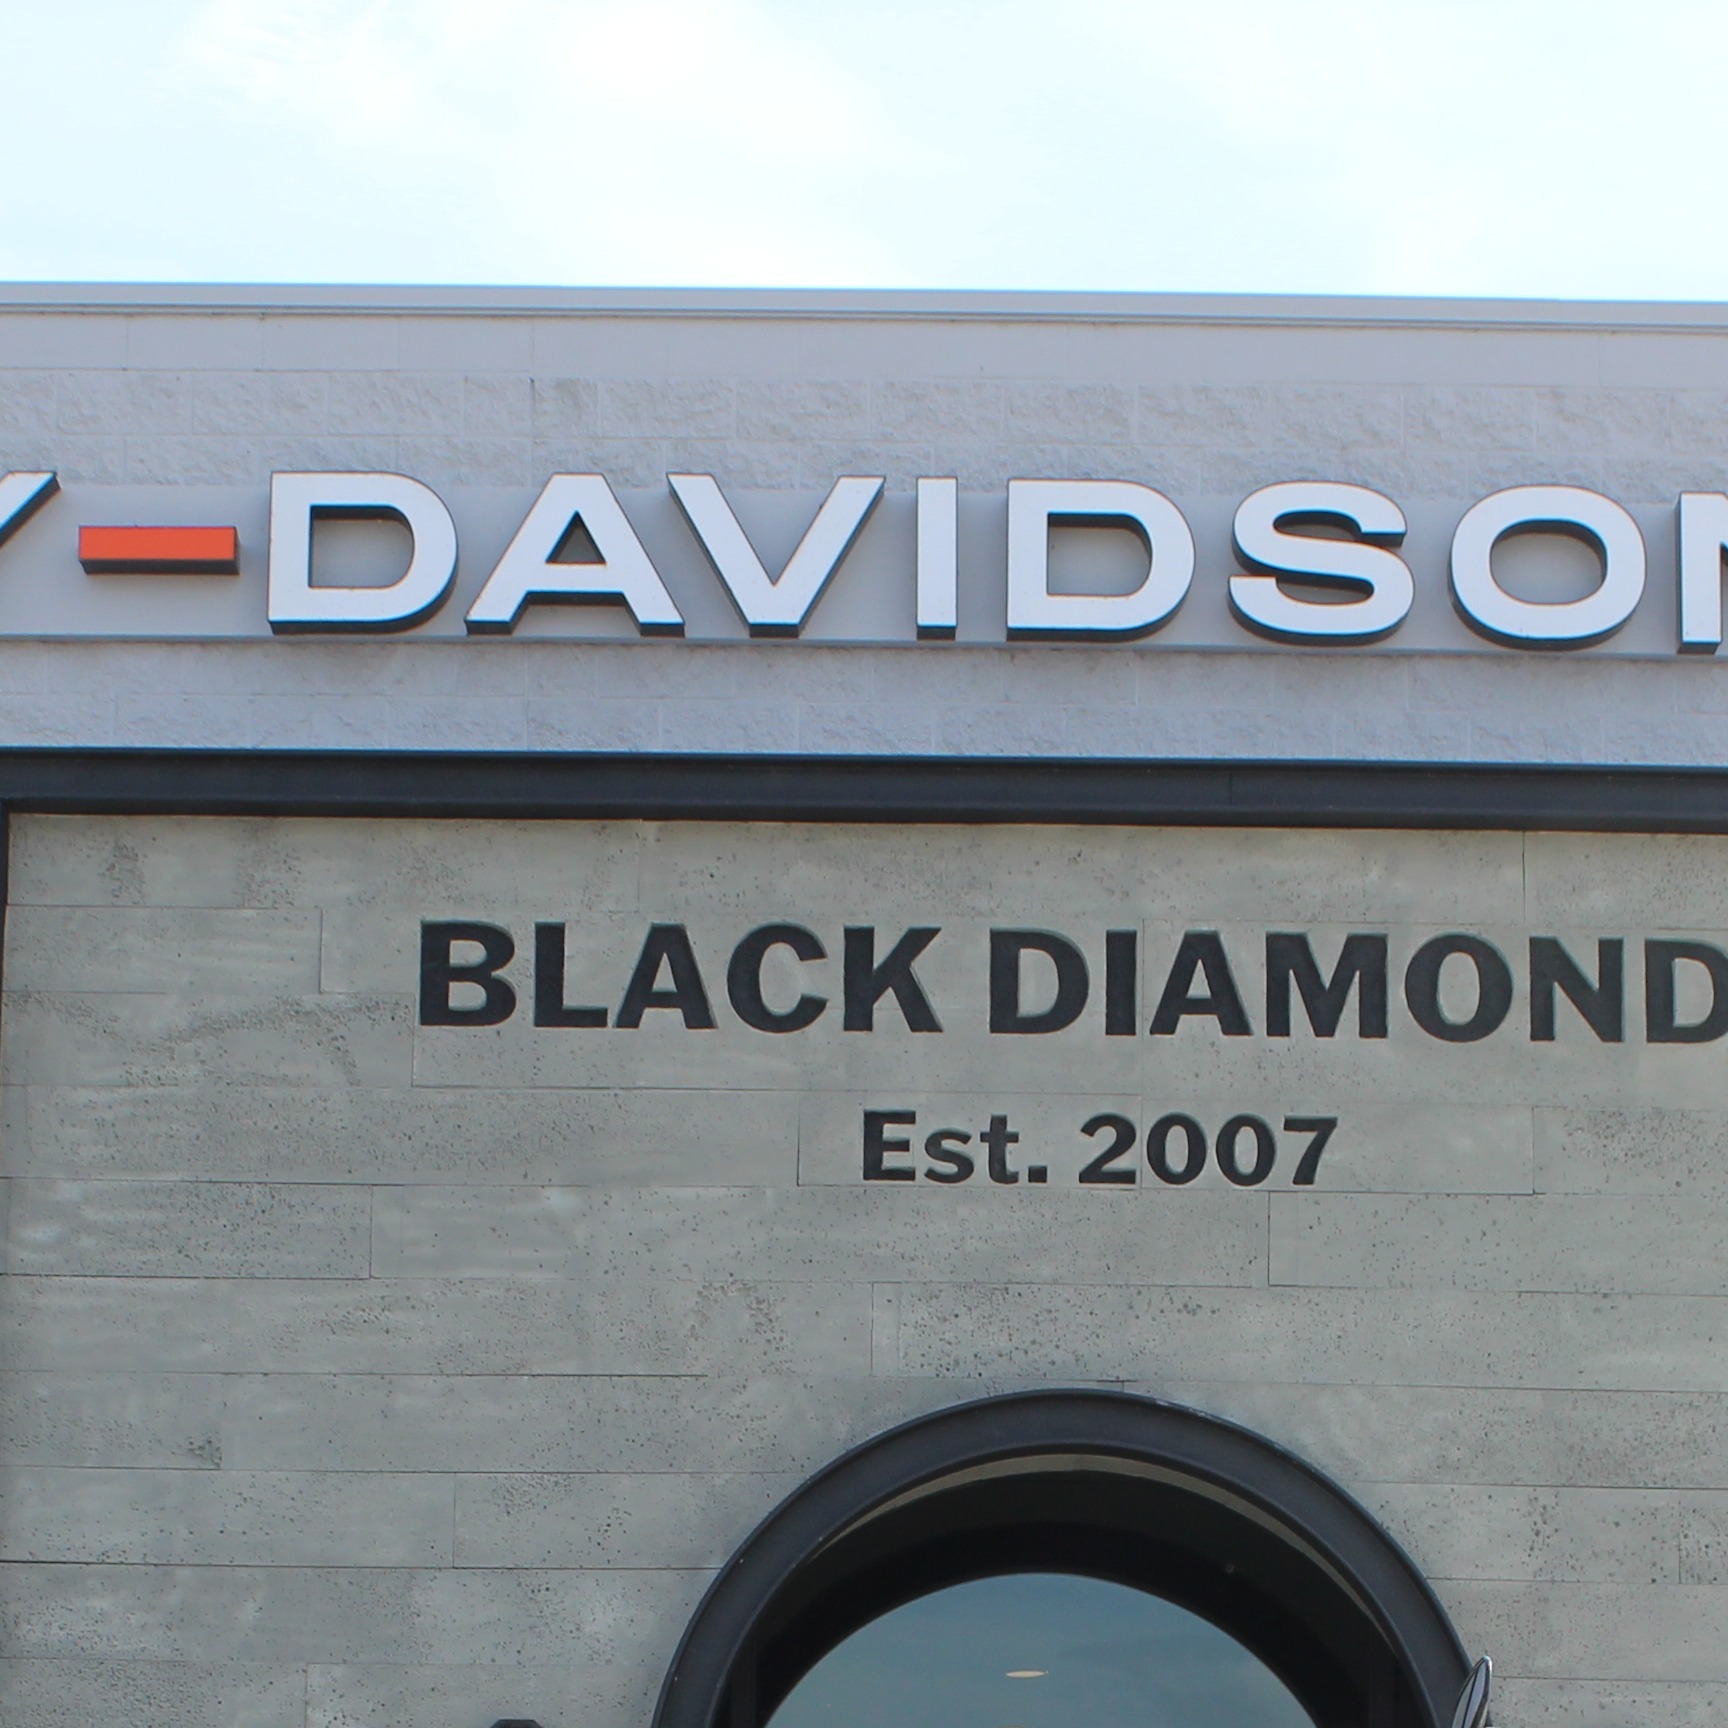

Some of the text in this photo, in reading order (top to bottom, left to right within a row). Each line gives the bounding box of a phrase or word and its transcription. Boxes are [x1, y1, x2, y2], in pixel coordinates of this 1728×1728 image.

[419, 920, 943, 1035] BLACK
[861, 1109, 1339, 1187] Est. 2007
